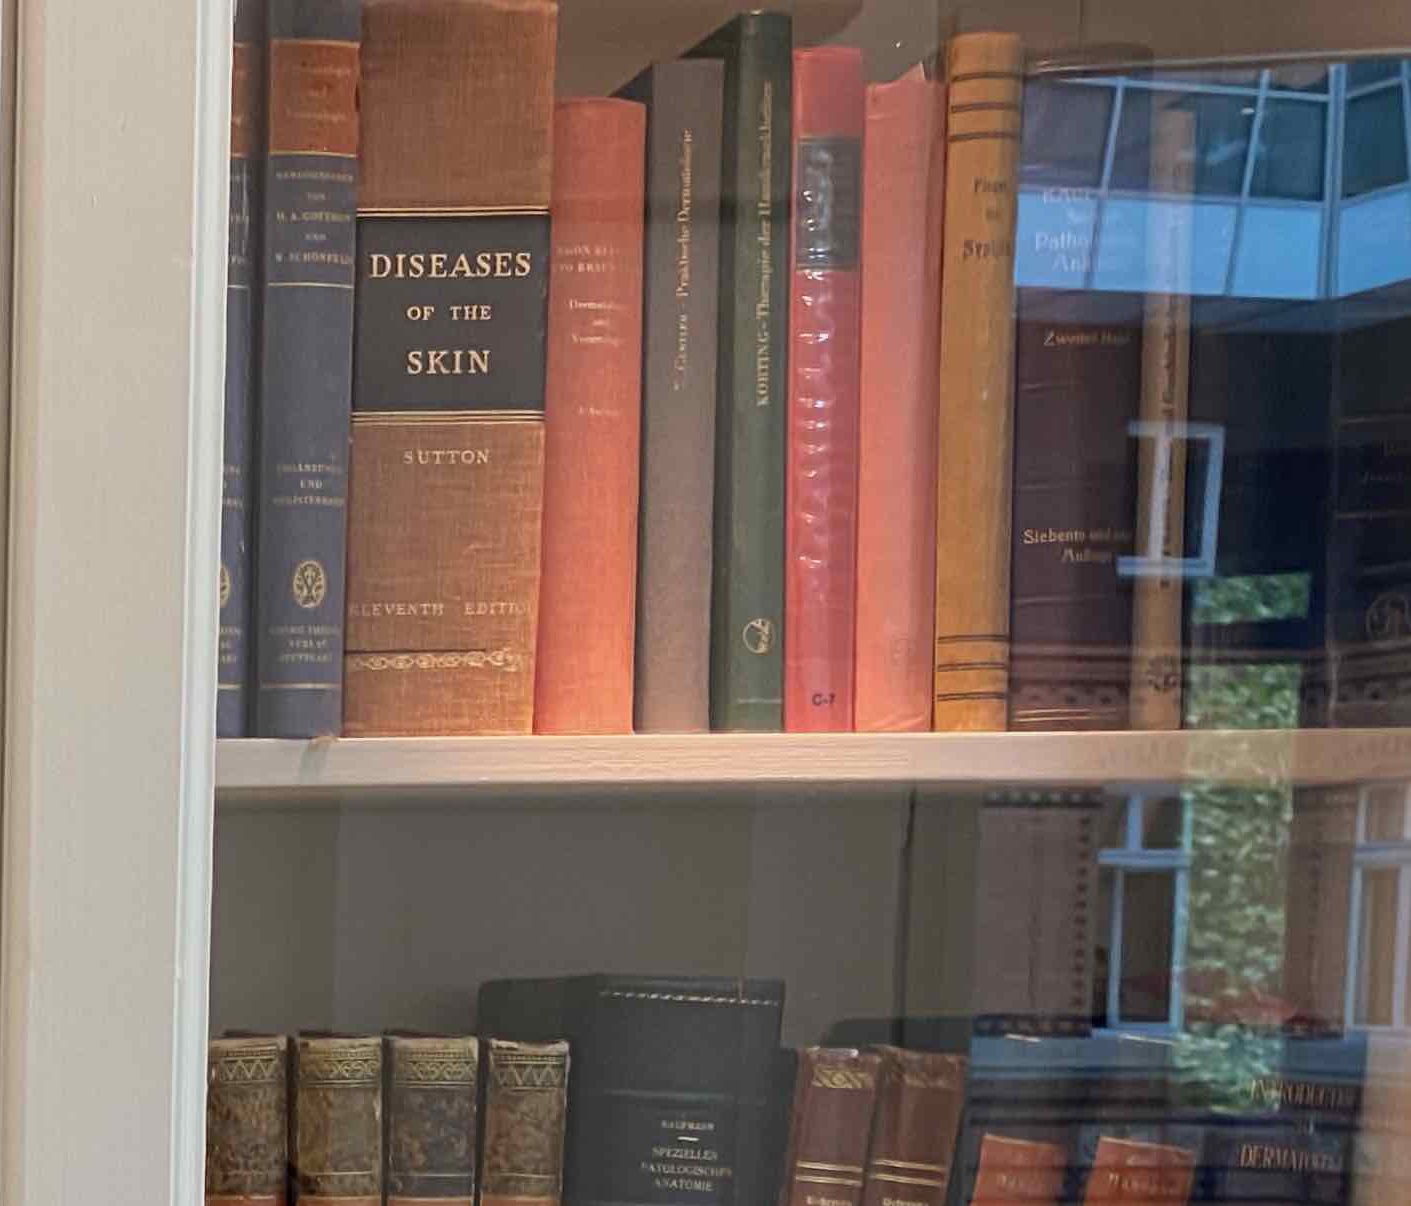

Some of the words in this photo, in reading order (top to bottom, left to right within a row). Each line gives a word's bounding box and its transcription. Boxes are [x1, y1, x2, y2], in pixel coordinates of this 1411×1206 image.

[368, 251, 533, 280] DISEASES
[405, 304, 436, 322] OF
[449, 303, 493, 321] THE
[406, 349, 492, 376] SKIN
[402, 448, 491, 465] SUTTON
